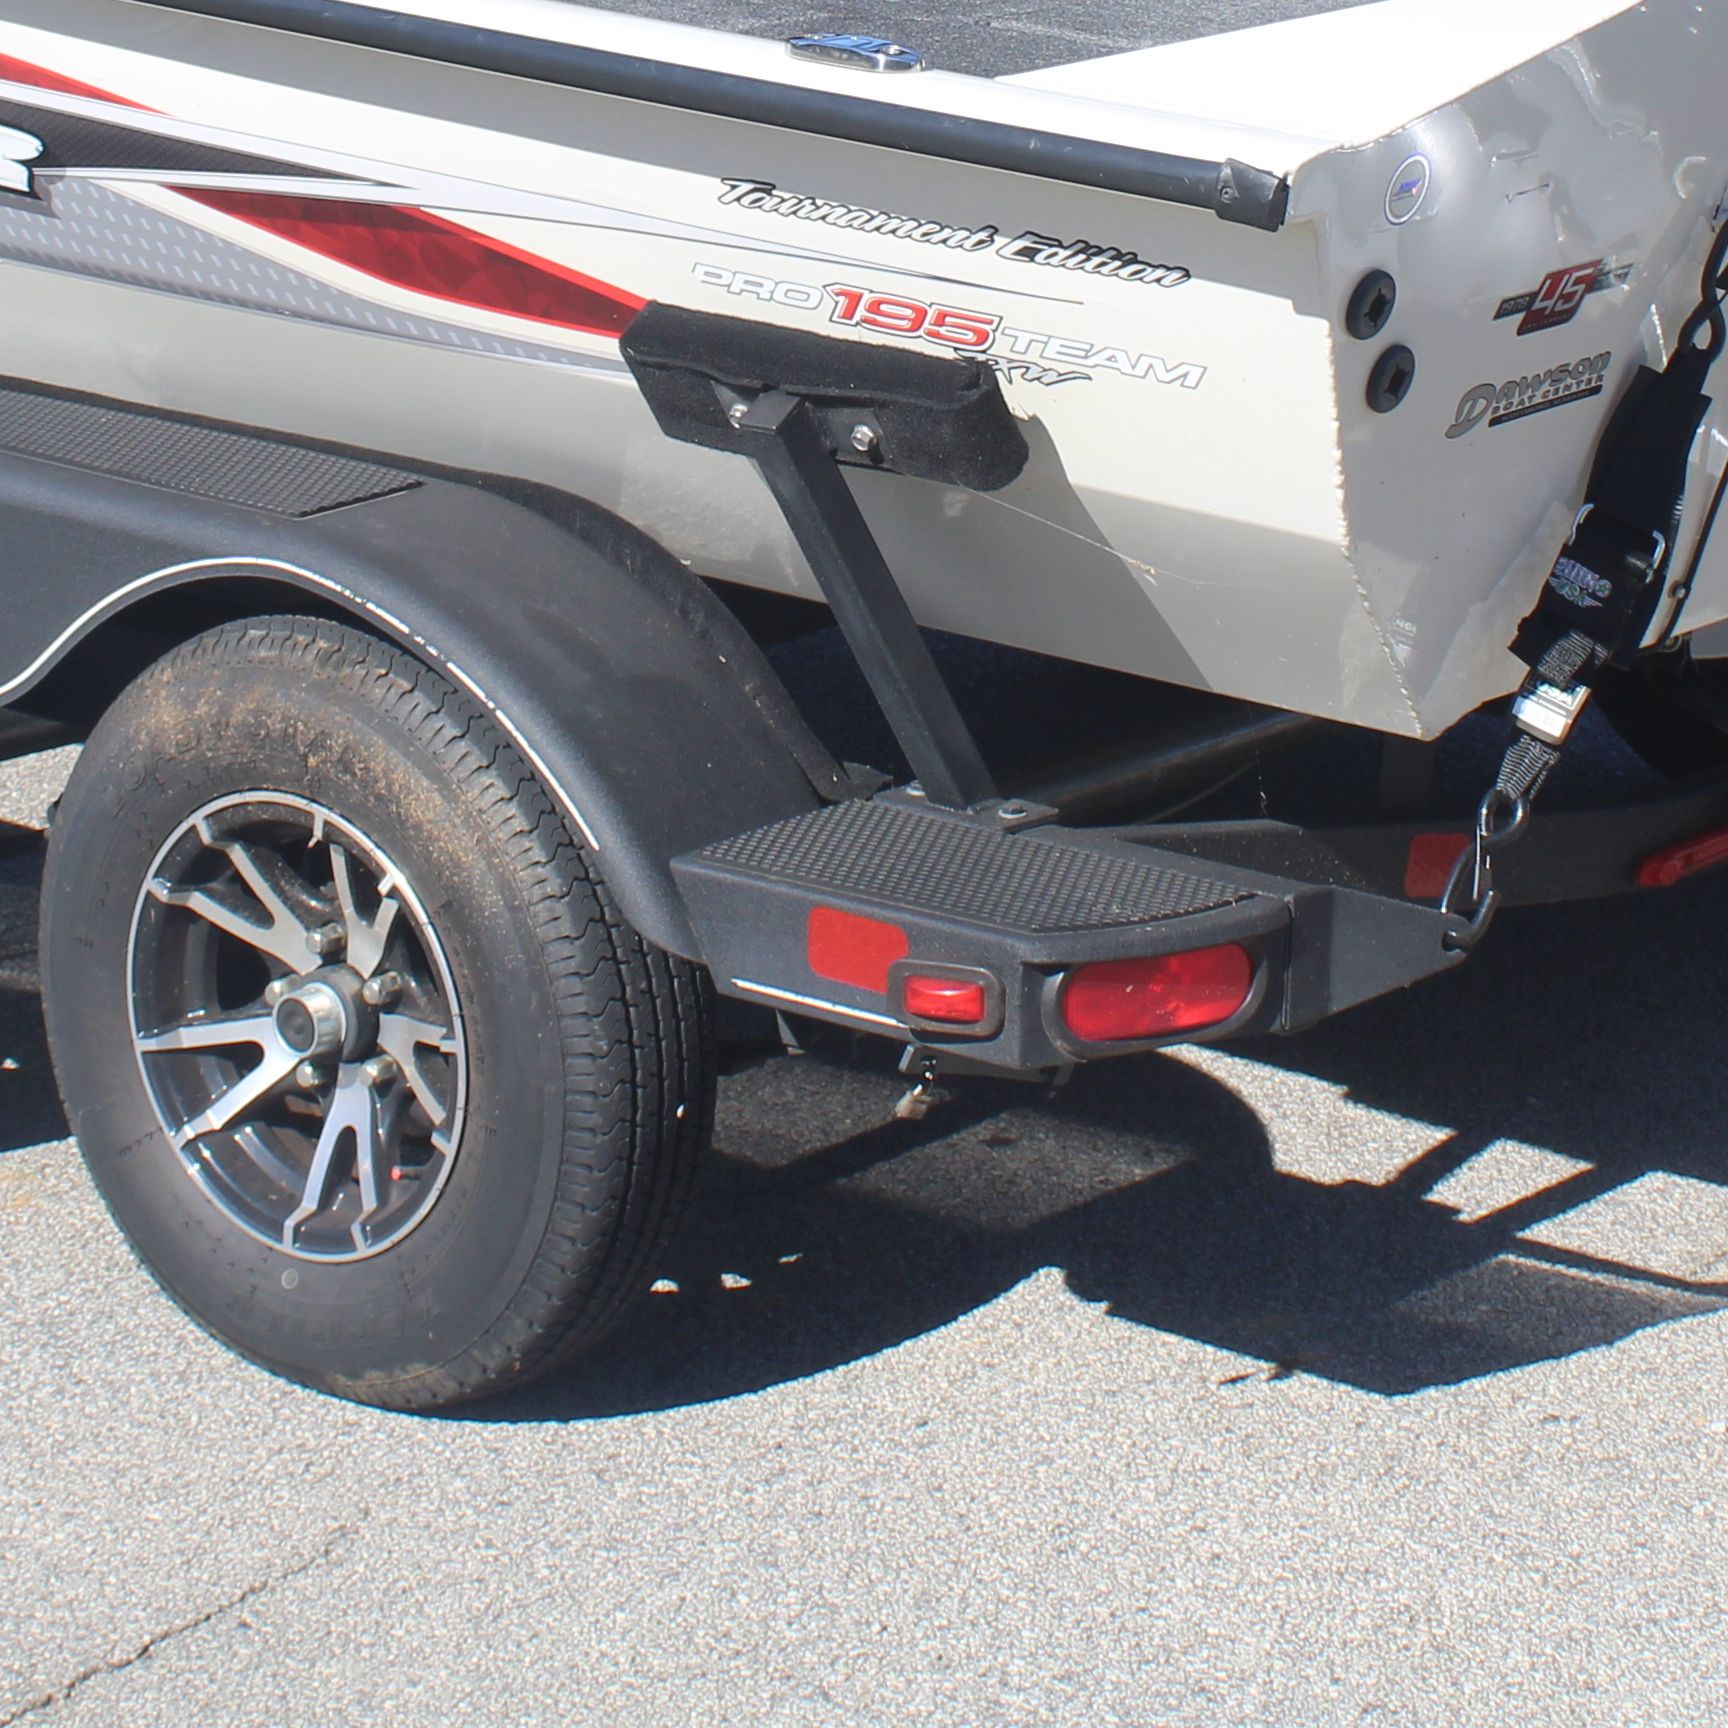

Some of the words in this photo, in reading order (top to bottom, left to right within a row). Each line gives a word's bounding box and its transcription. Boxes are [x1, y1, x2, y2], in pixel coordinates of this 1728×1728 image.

[721, 178, 998, 252] Tournament
[999, 230, 1190, 288] Edition
[692, 262, 824, 309] PRO
[824, 283, 1002, 351] 195
[1001, 327, 1207, 389] TEAM
[1531, 268, 1596, 315] 45
[1491, 394, 1535, 416] BOAT
[1541, 373, 1606, 400] CENTER
